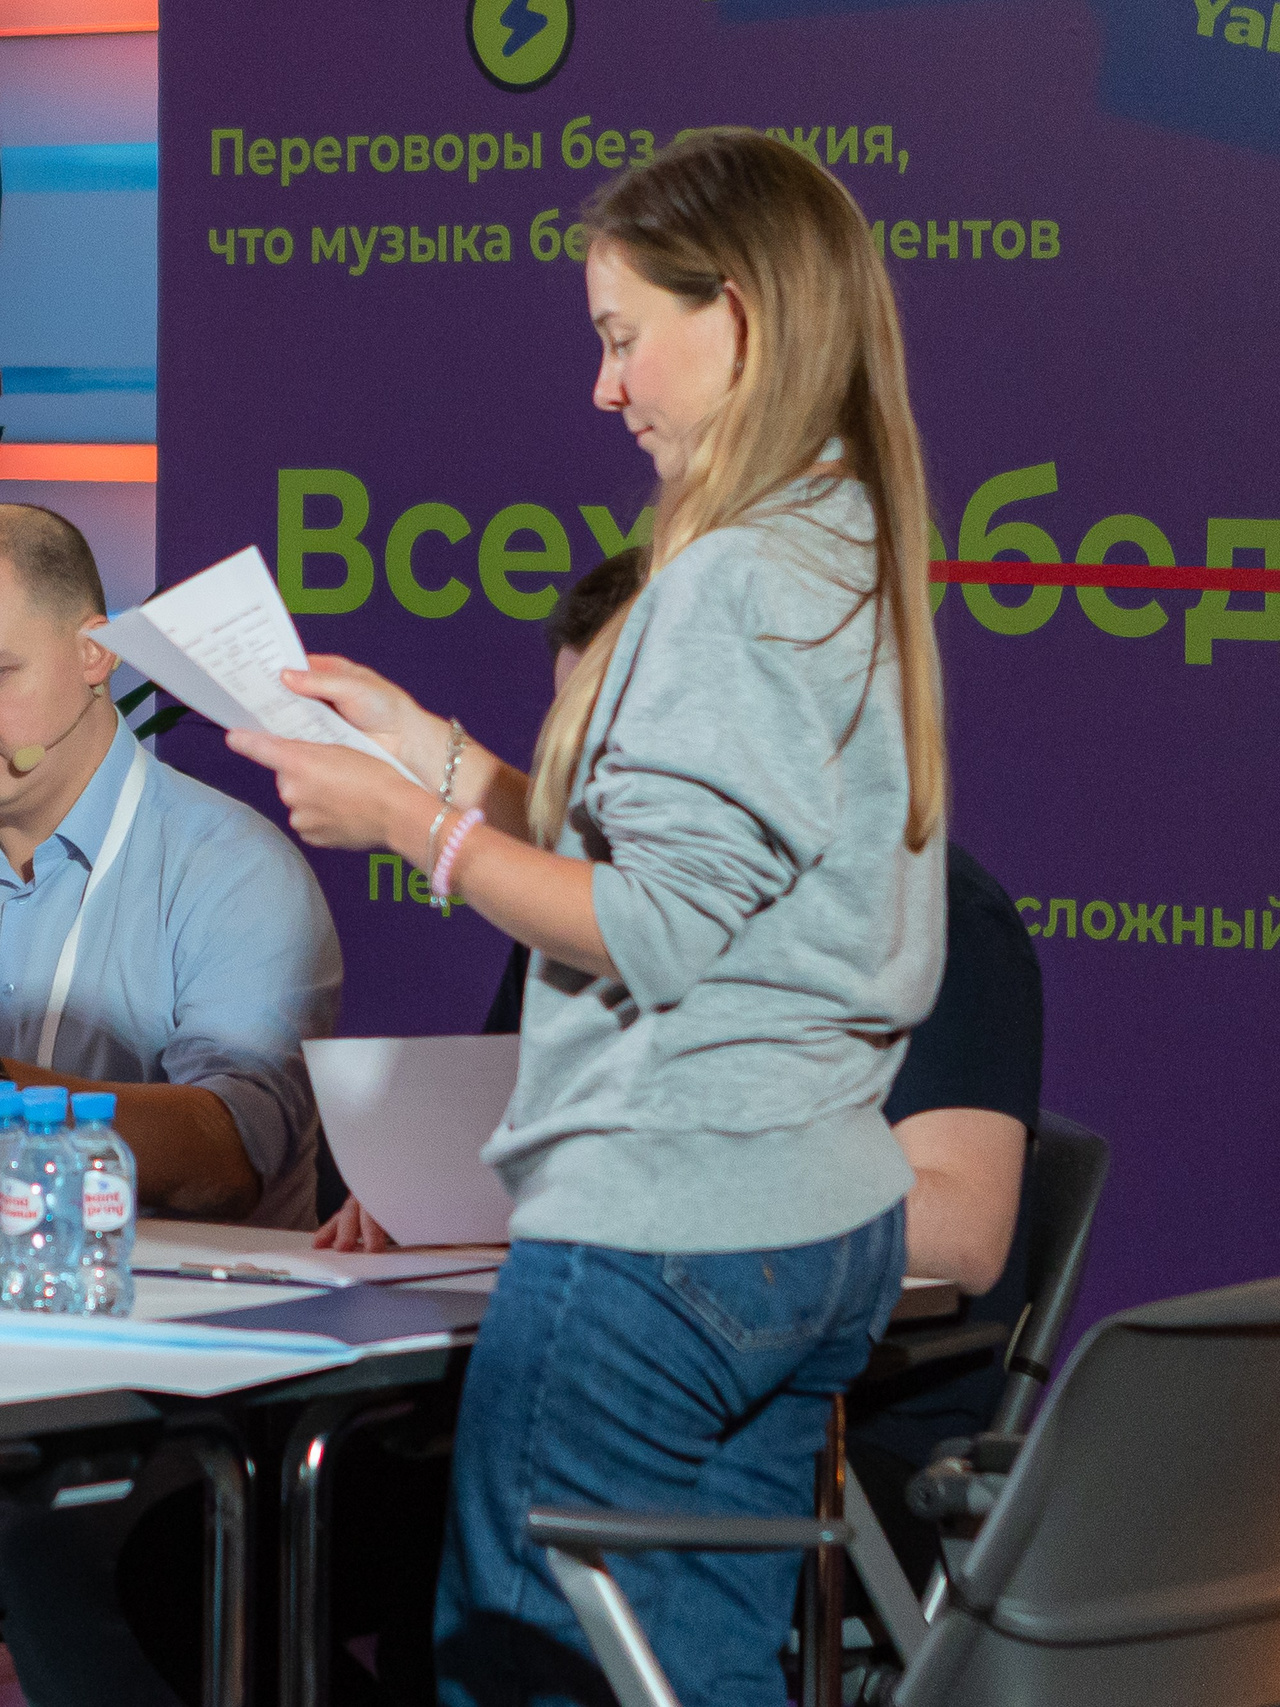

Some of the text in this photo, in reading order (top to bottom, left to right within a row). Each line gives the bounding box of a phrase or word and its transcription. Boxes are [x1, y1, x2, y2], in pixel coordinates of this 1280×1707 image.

[211, 129, 543, 186] Переговоры
[561, 116, 655, 169] без
[209, 228, 295, 265] что
[311, 223, 512, 276] музыка
[529, 208, 588, 262] бе
[928, 461, 1280, 665] бед
